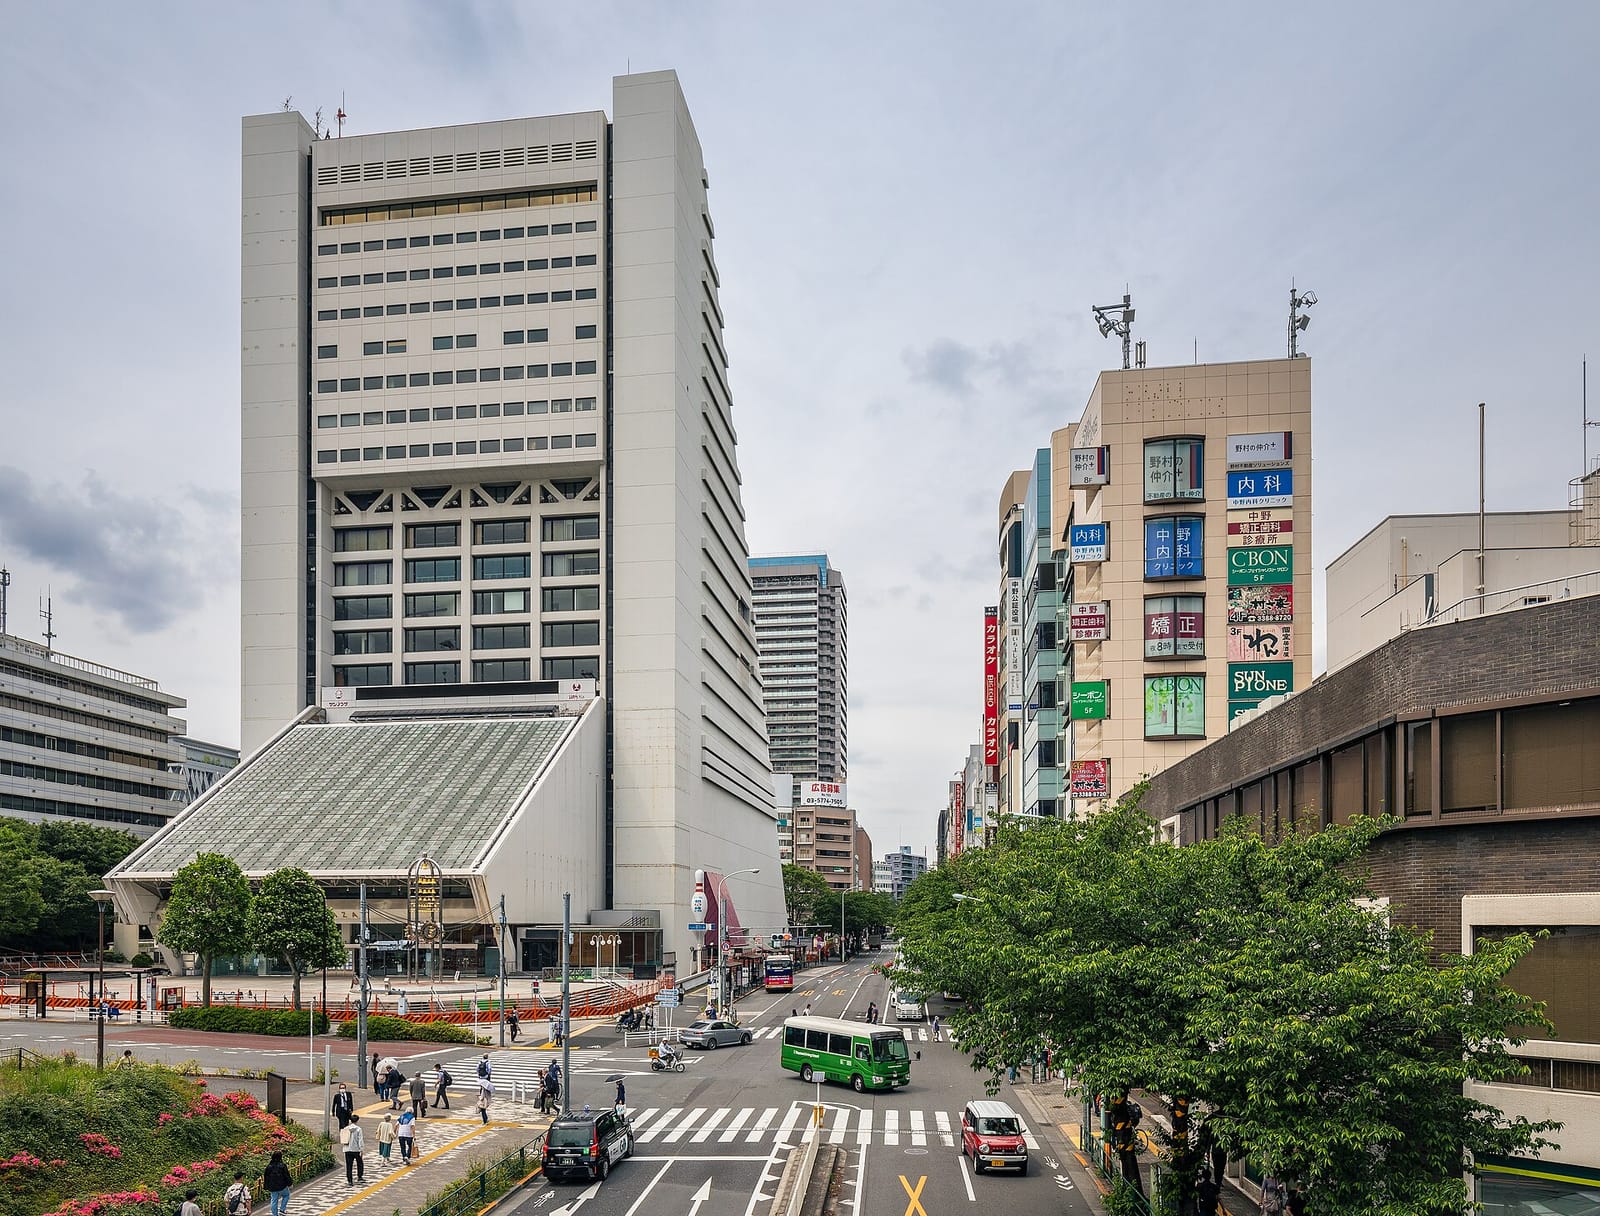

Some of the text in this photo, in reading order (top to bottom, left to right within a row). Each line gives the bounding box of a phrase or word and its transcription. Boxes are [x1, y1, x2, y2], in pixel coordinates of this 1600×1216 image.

[1238, 474, 1282, 494] 内科
[1248, 511, 1272, 521] 中野
[1156, 527, 1191, 542] 中野
[1240, 521, 1280, 534] 矯正歯科
[1075, 528, 1102, 543] 内科
[1243, 534, 1278, 545] 診療所
[1156, 544, 1191, 559] 内科
[1078, 605, 1098, 614] 中野
[1151, 616, 1196, 635] 矯正
[1230, 627, 1242, 636] 3F
[986, 624, 997, 665] カラオケ
[986, 717, 997, 758] カラオケ
